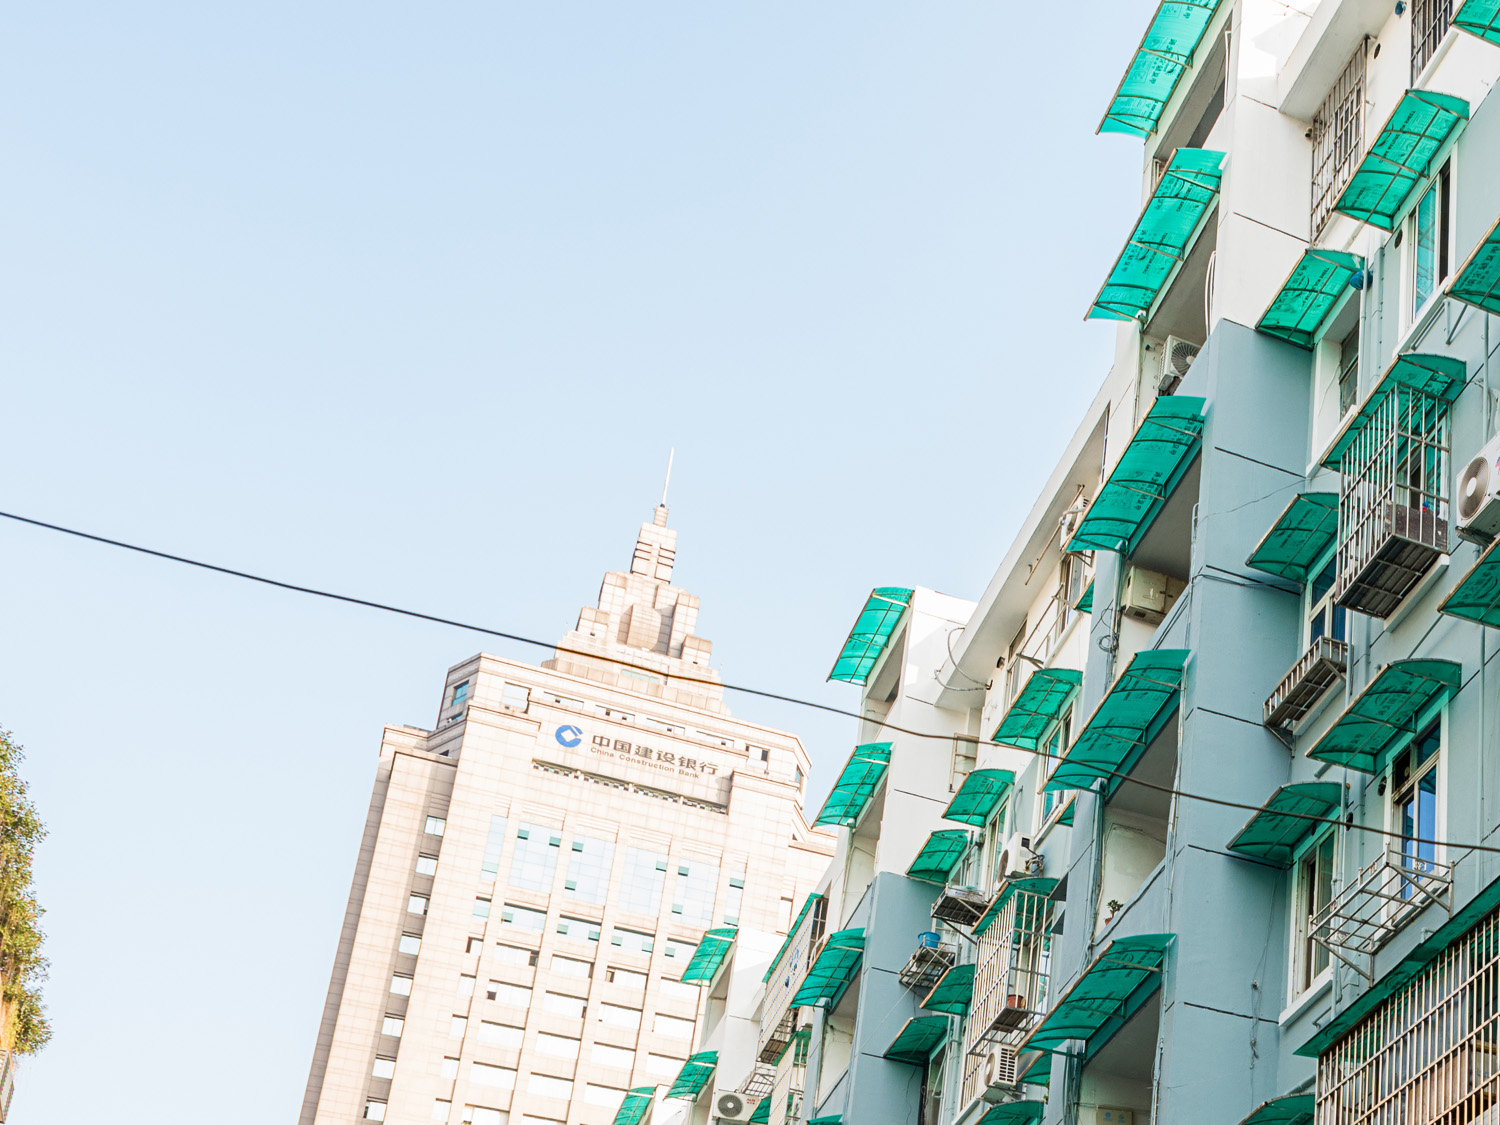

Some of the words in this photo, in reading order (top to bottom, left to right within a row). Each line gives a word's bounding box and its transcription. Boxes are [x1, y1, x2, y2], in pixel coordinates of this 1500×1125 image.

[590, 747, 615, 758] China
[619, 754, 675, 773] Construction
[678, 769, 700, 779] Bank
[592, 735, 718, 775] 中国建设银行
